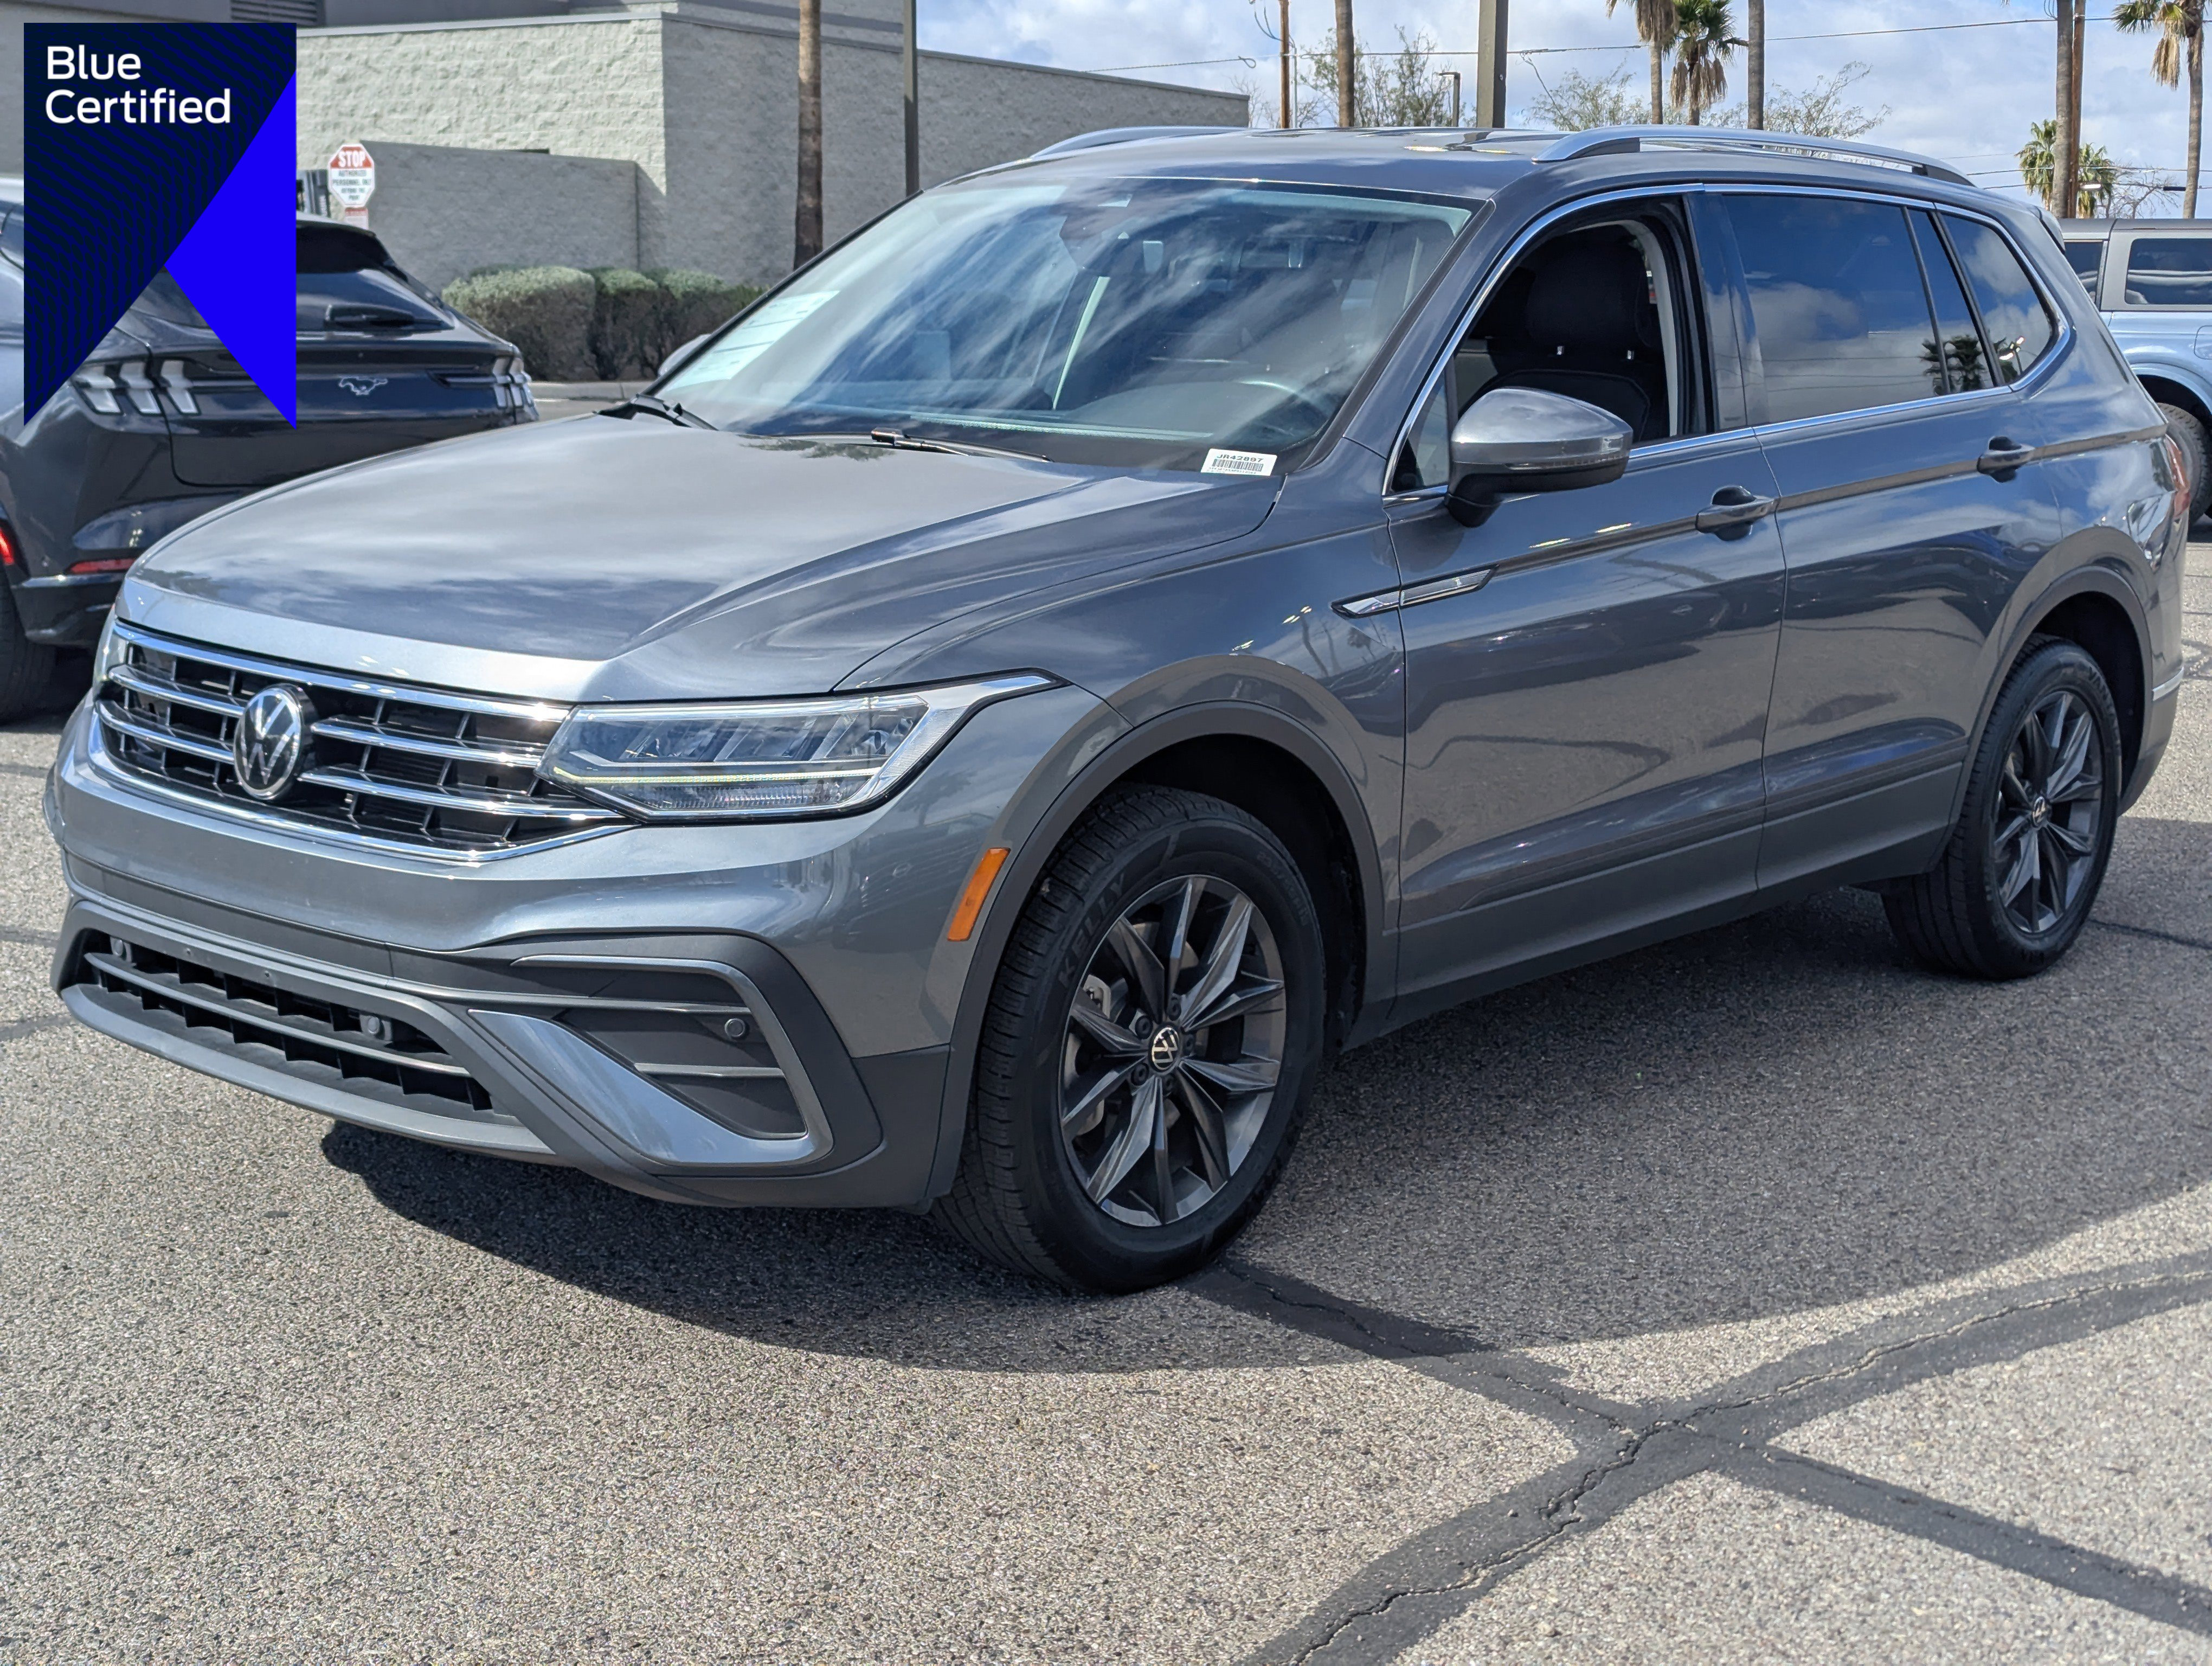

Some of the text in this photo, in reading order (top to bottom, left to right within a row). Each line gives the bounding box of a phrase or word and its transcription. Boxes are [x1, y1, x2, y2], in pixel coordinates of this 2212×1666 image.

[338, 150, 366, 168] STOP
[1217, 454, 1264, 463] JR42897
[1058, 872, 1124, 989] KELLY
